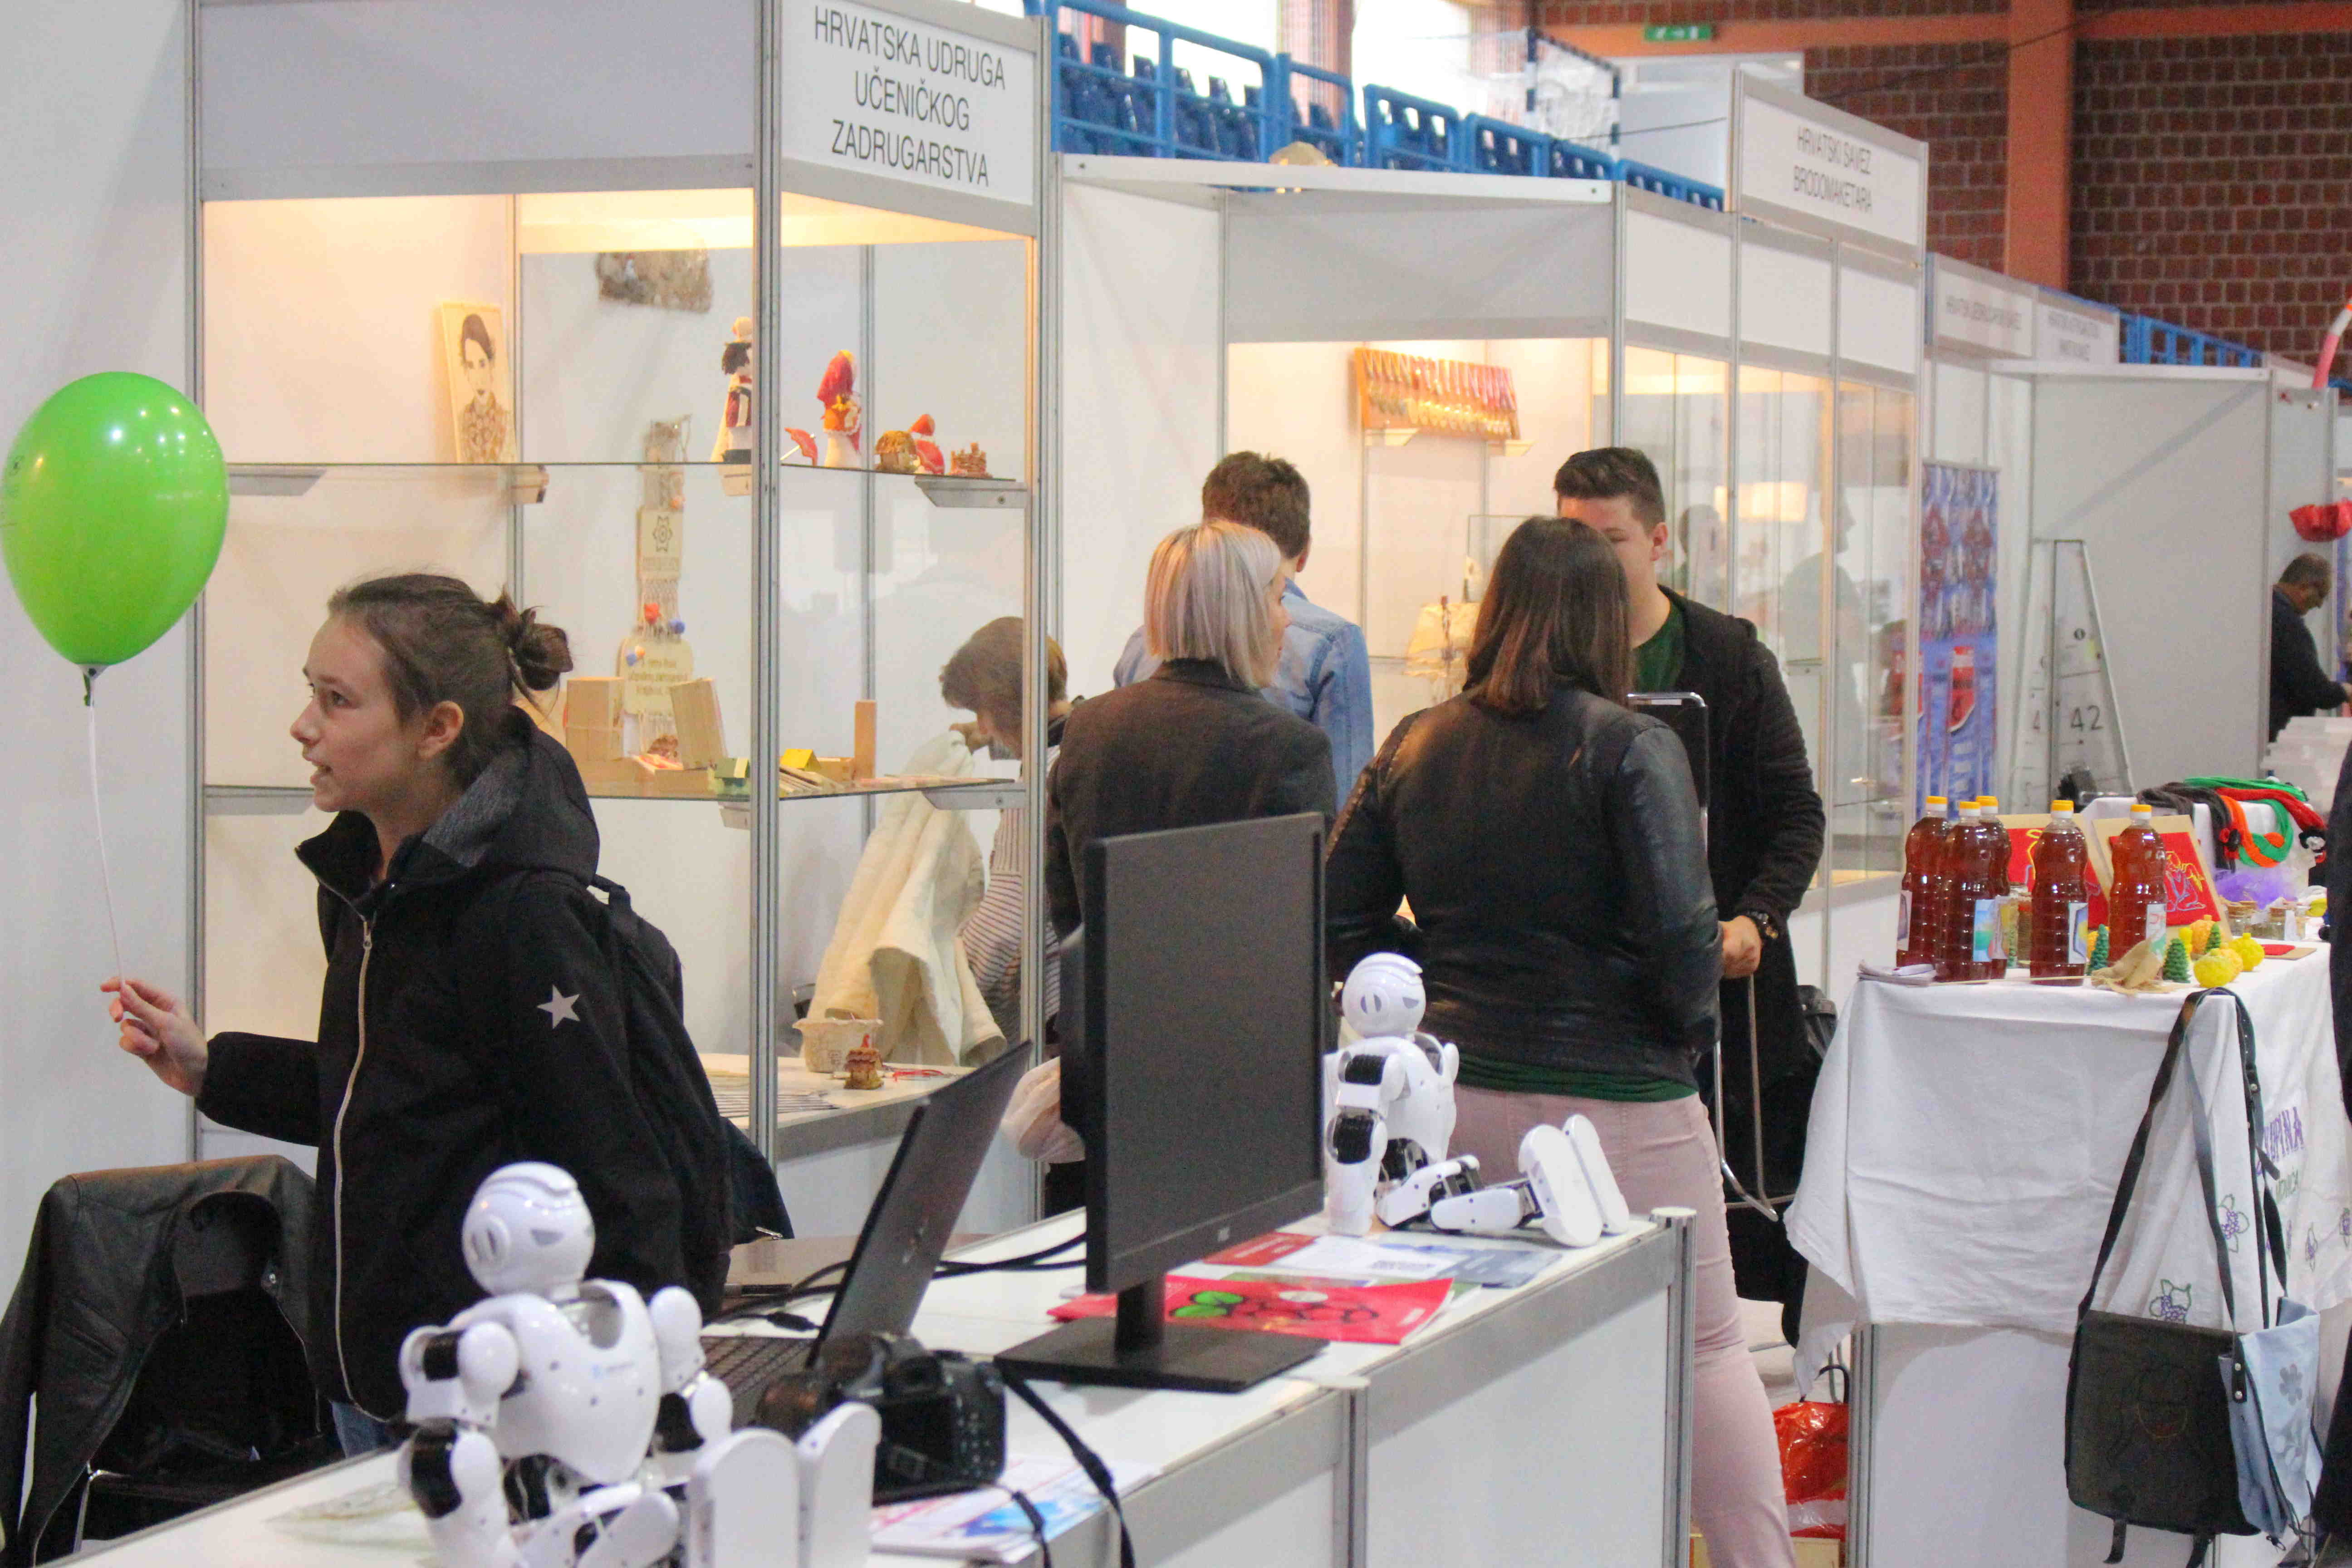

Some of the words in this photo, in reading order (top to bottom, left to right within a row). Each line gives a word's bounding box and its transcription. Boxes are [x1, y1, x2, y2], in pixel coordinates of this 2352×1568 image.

[815, 5, 921, 68] HRVATSKA
[927, 37, 1006, 90] UDRUGA
[855, 66, 970, 132] UČENIČKOG
[832, 119, 989, 187] ZADRUGARSTVA
[2070, 704, 2105, 732] 42
